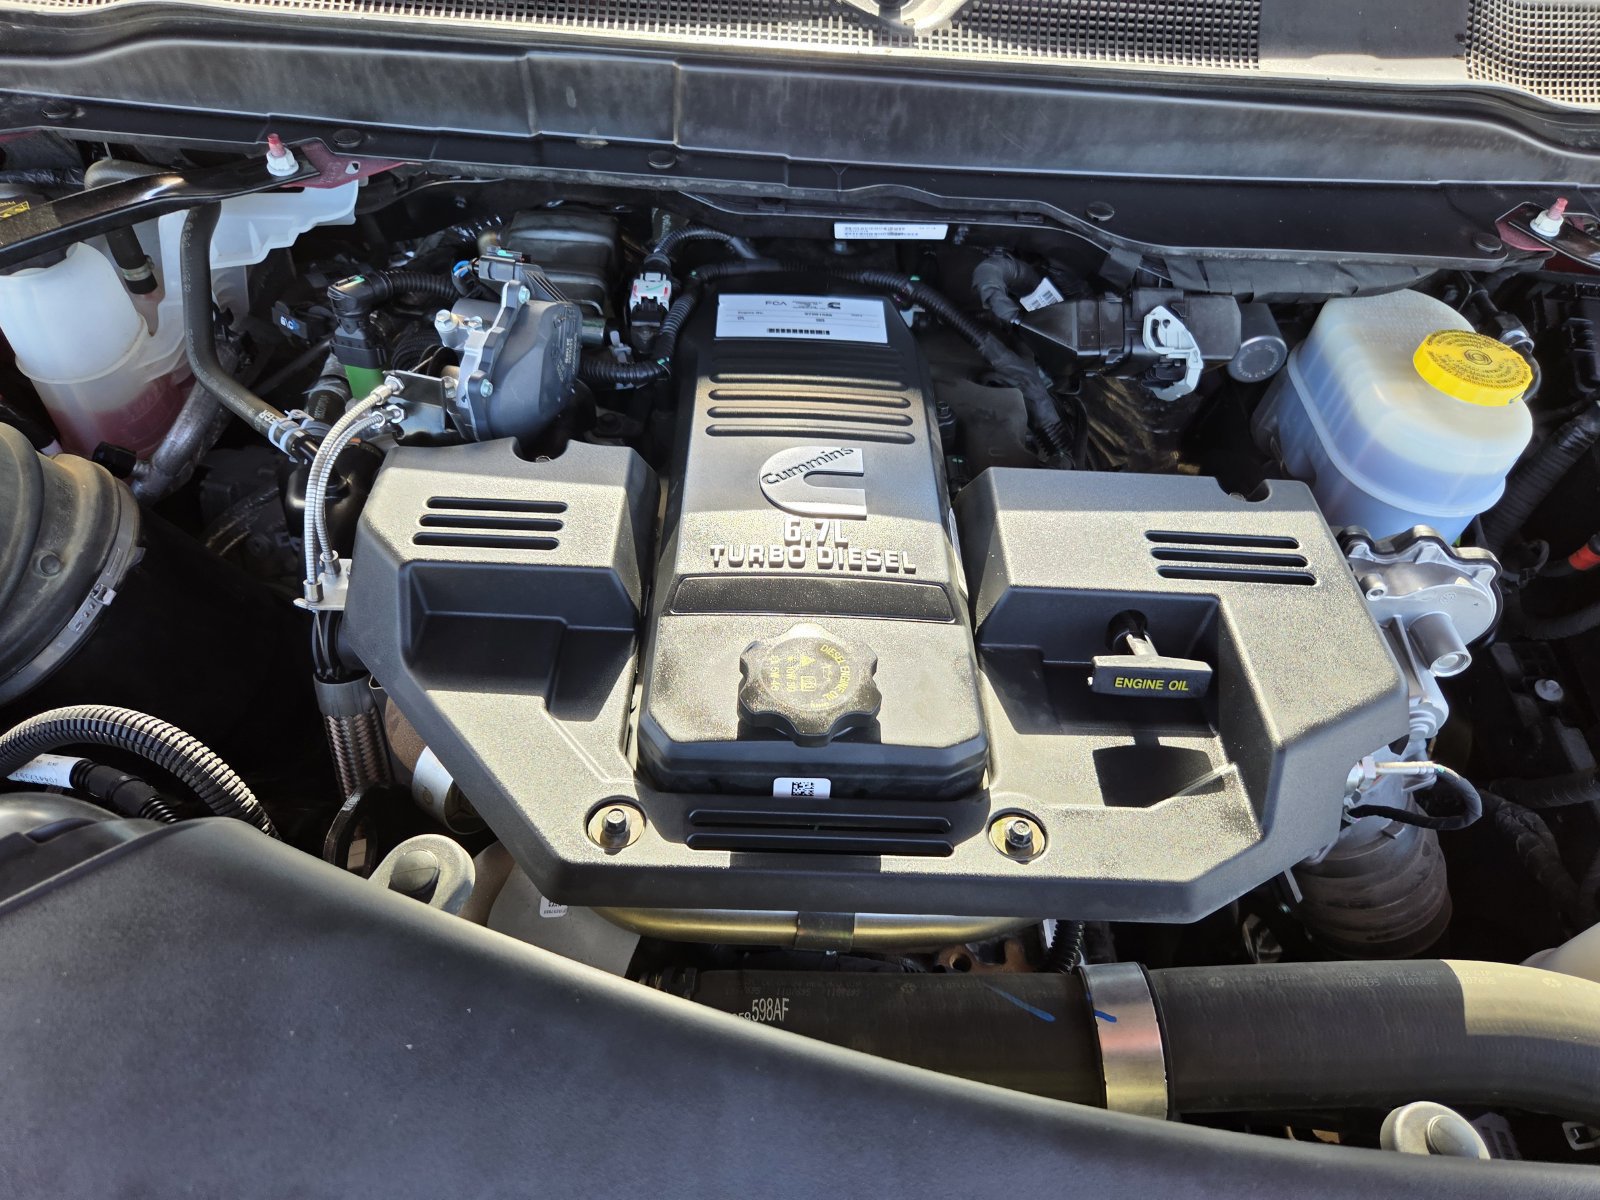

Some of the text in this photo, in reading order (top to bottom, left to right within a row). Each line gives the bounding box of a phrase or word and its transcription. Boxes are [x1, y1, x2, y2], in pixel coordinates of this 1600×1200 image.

[761, 446, 855, 485] Cummins
[784, 519, 849, 549] 6.7L
[710, 544, 917, 574] TURBO DIESEL
[820, 644, 846, 665] DIESEL
[839, 665, 851, 694] ENGINE
[1114, 676, 1189, 691] ENGINE OIL
[752, 998, 790, 1021] 598AF
